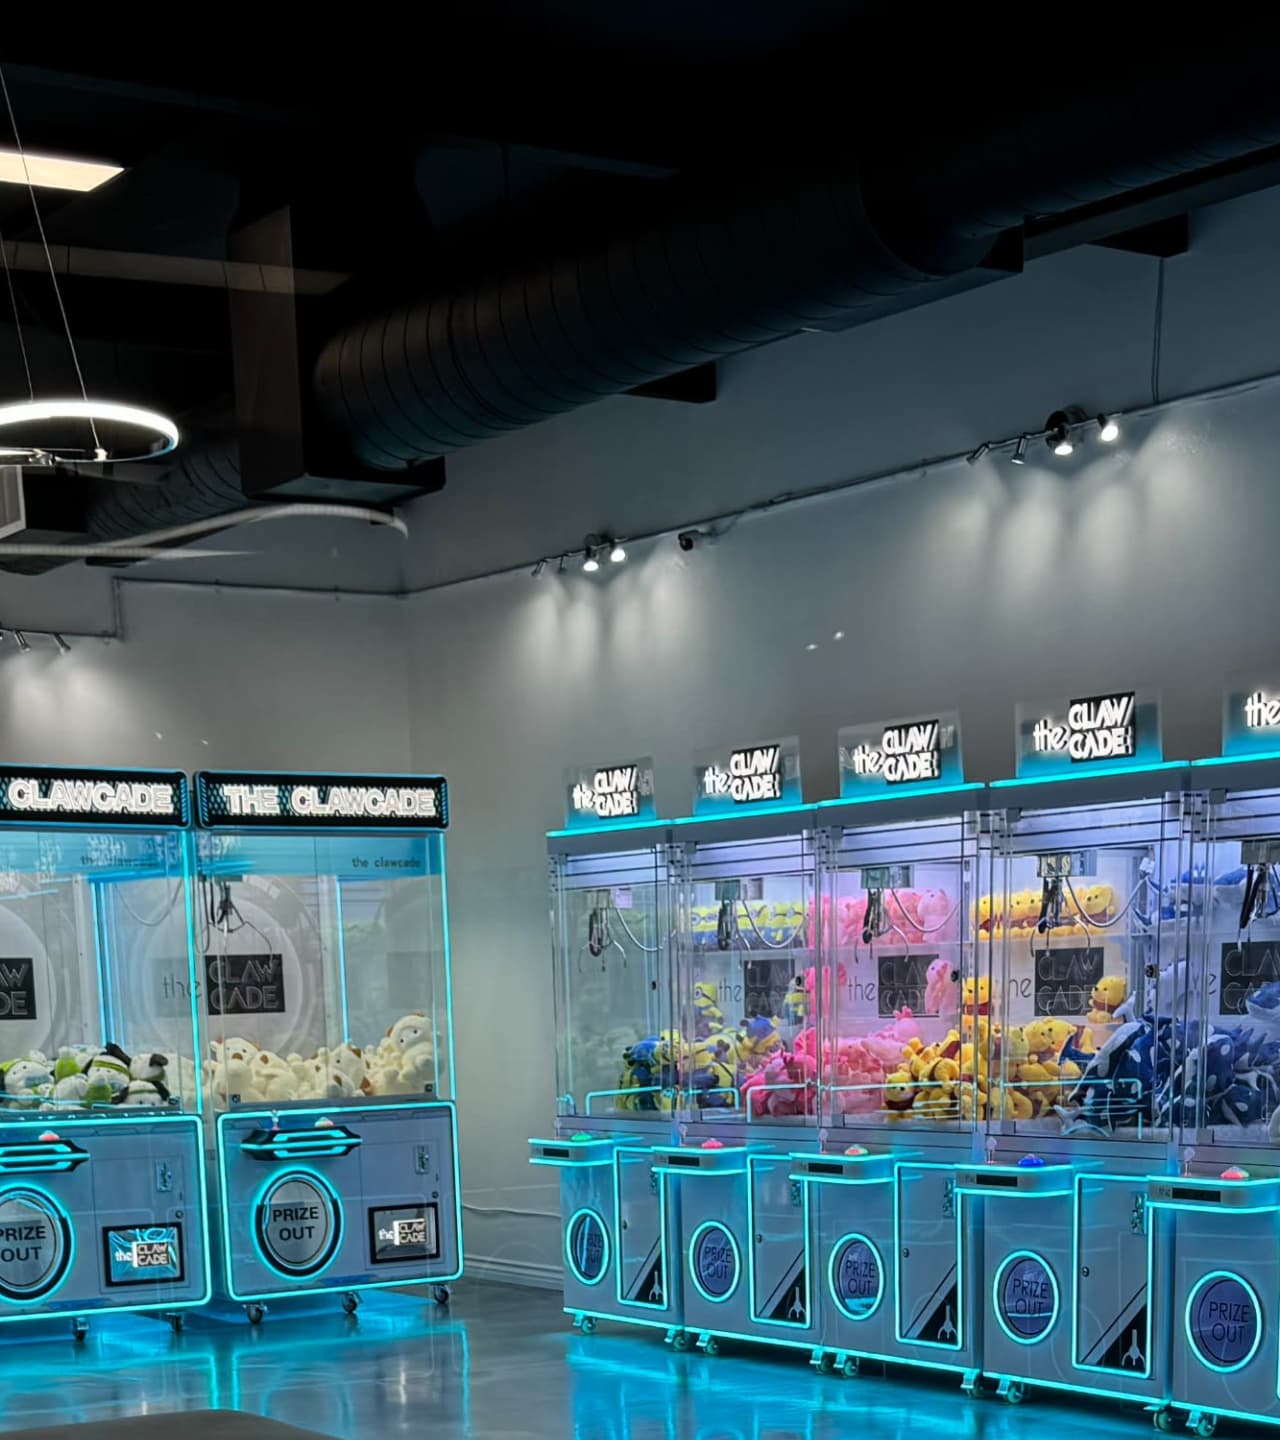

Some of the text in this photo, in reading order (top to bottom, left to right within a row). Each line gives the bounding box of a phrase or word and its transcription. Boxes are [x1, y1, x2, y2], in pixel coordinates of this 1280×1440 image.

[1069, 697, 1134, 730] CLAW
[882, 724, 938, 753] CLAW
[1033, 720, 1067, 751] the
[1070, 727, 1133, 760] CADE
[730, 748, 779, 776] CLAW
[853, 745, 882, 775] the
[884, 752, 939, 782] CADE
[594, 767, 637, 793] CLAW
[704, 767, 731, 794] the
[731, 775, 780, 800] CADE
[8, 780, 174, 813] CLAWCADE
[222, 785, 437, 817] THE CLAWCADE
[573, 784, 596, 809] the
[595, 792, 637, 816] CADE
[352, 857, 421, 868] the clawcade
[847, 975, 877, 1001] the
[272, 1206, 319, 1222] PRIZE
[279, 1226, 315, 1241] OUT
[0, 1247, 42, 1263] OUT
[115, 1250, 133, 1263] the
[137, 1243, 169, 1254] CLAW
[137, 1254, 169, 1265] CADE
[845, 1259, 876, 1279] PRIZE
[848, 1278, 873, 1295] OUT
[1012, 1278, 1049, 1299] PRIZE
[1016, 1298, 1045, 1316] OUT
[1209, 1301, 1250, 1323] PRIZE
[1212, 1322, 1246, 1345] OUT
